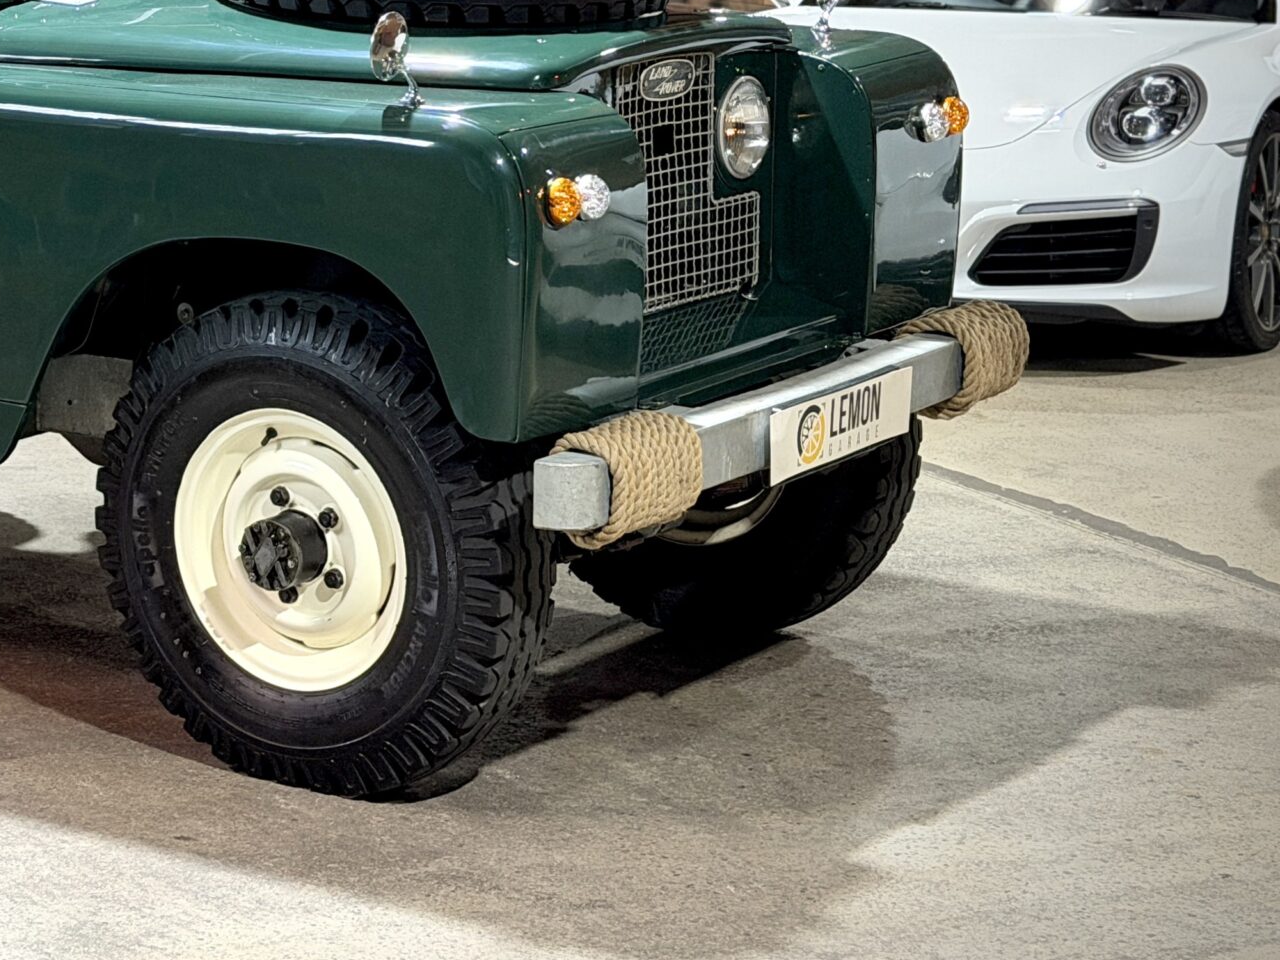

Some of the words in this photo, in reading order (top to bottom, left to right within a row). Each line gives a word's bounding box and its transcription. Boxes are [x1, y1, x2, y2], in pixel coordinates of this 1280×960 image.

[648, 65, 673, 81] LAND
[658, 79, 687, 96] ROVER
[829, 381, 882, 438] LEMON
[828, 424, 880, 457] GARAGE
